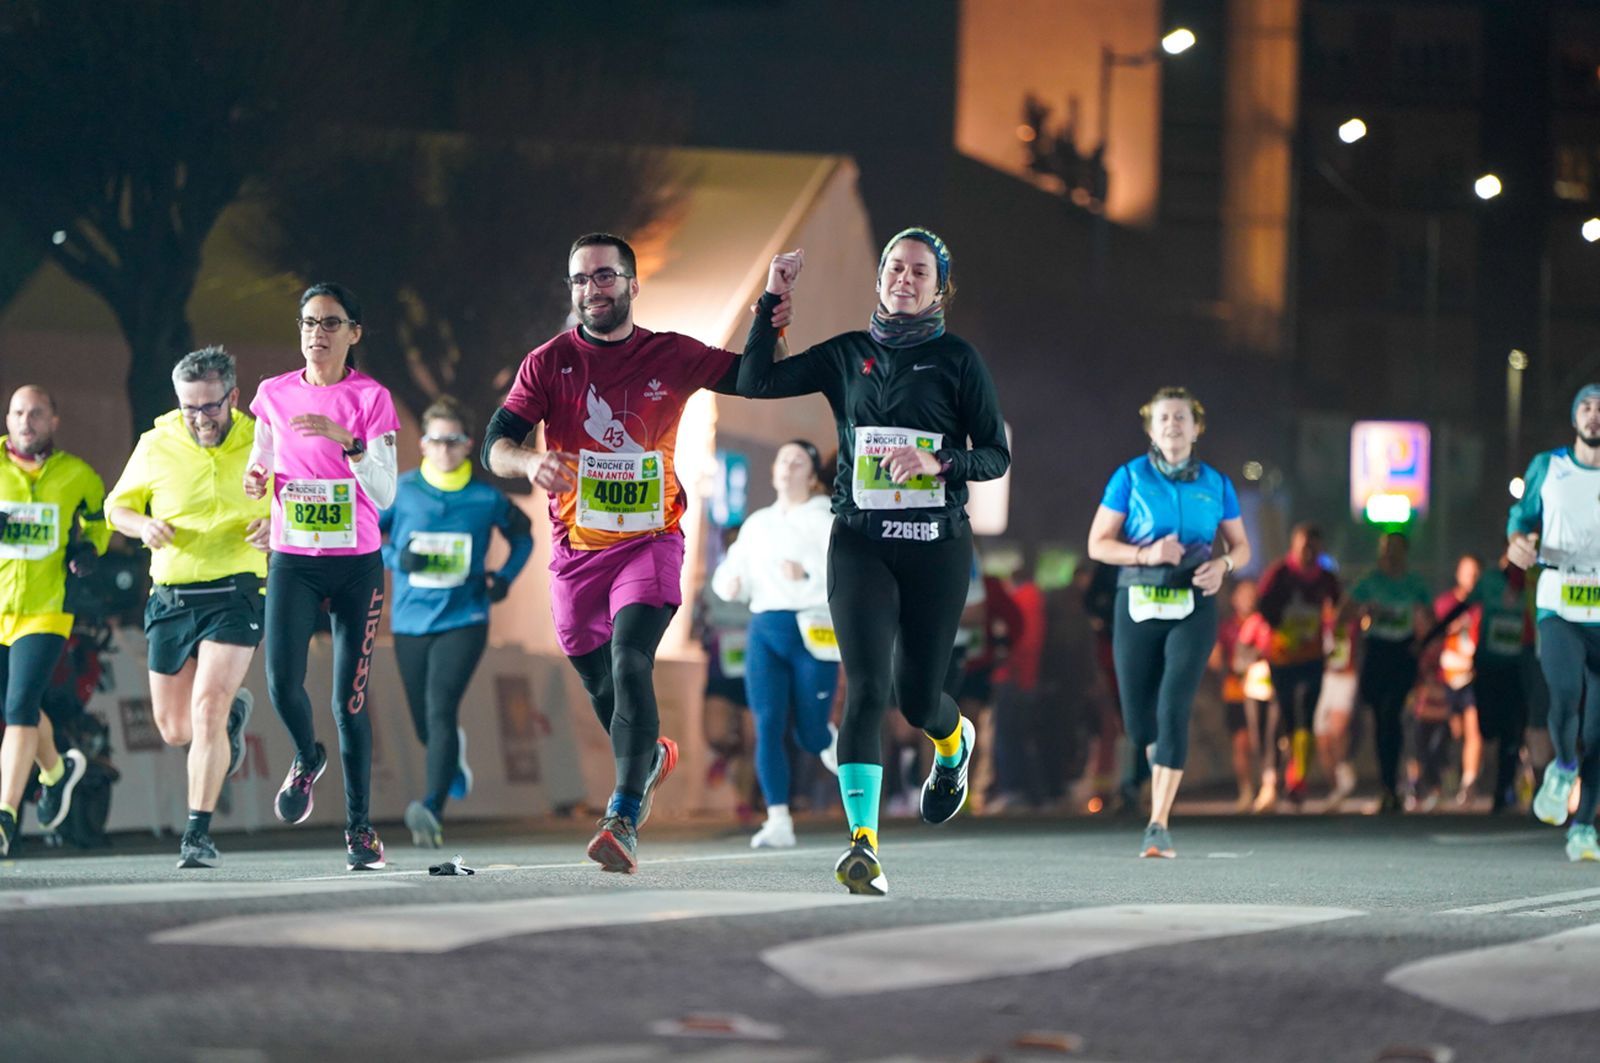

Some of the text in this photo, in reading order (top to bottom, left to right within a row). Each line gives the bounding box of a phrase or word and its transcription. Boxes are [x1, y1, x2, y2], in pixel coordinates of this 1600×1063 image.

[603, 427, 624, 447] 43
[873, 436, 896, 445] NOCHE
[864, 446, 880, 454] SAN
[596, 462, 635, 471] NOCHE DE
[586, 469, 603, 479] SAN
[605, 470, 635, 480] ANTÓN
[296, 486, 317, 494] NOCHE
[594, 481, 649, 505] 4087
[295, 503, 341, 525] 8243
[7, 522, 49, 540] 13421
[881, 519, 940, 541] 226ERS
